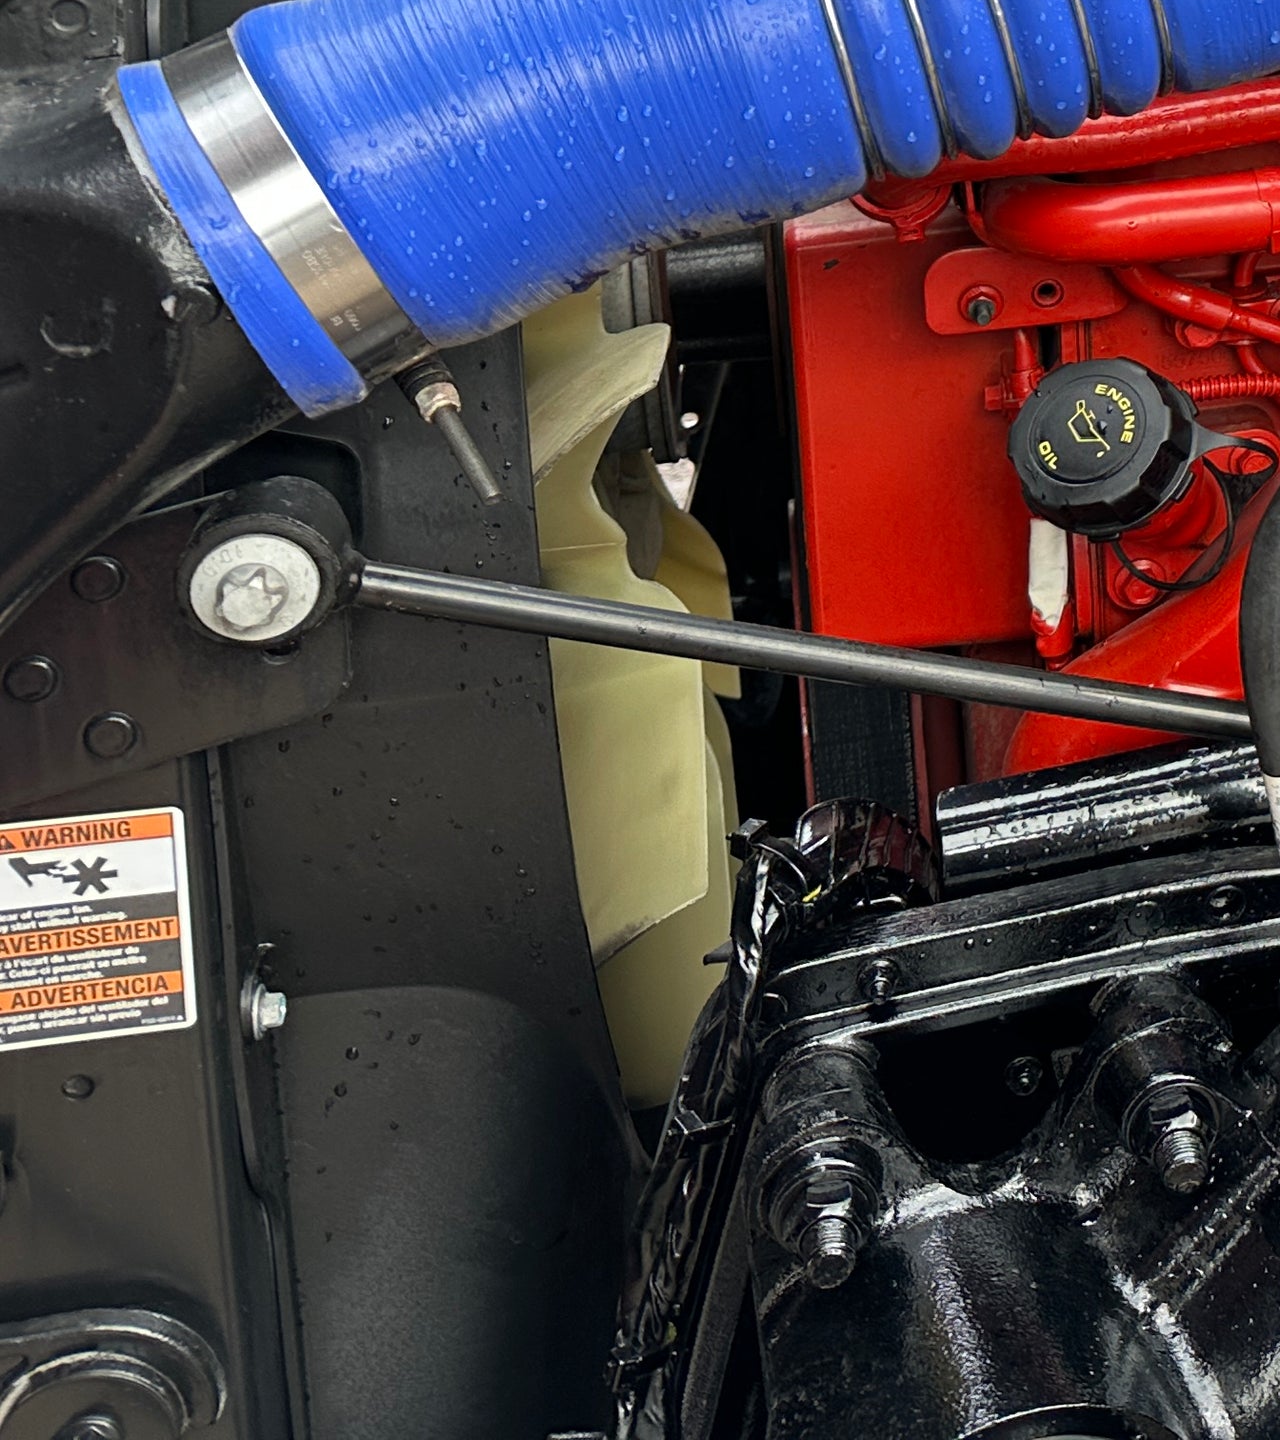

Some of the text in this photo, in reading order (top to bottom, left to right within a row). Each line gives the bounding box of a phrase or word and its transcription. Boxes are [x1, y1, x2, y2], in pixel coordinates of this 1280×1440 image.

[1094, 383, 1136, 444] ENGINE
[1038, 440, 1059, 470] OIL
[21, 820, 131, 849] WARNING
[34, 907, 71, 920] engine
[0, 918, 175, 955] AVERTISSEMENT
[11, 975, 169, 1010] ADVERTENCIA
